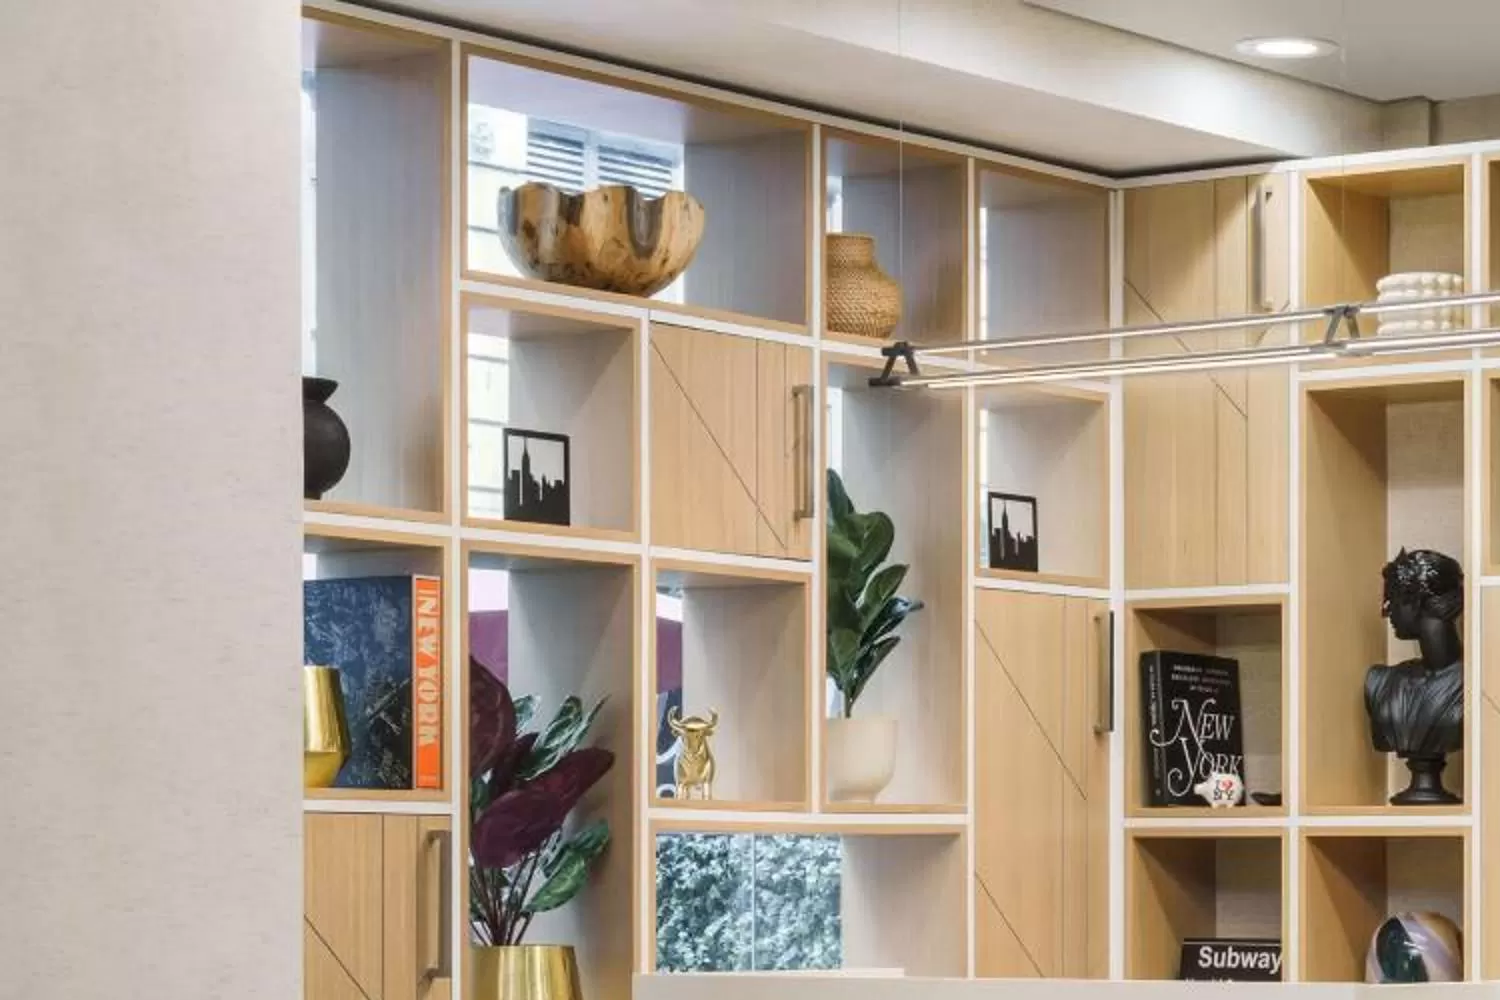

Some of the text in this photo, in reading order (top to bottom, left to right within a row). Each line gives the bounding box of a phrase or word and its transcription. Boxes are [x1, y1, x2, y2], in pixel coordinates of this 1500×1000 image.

[417, 588, 438, 745] NEW YORK
[1198, 945, 1281, 974] Subway
